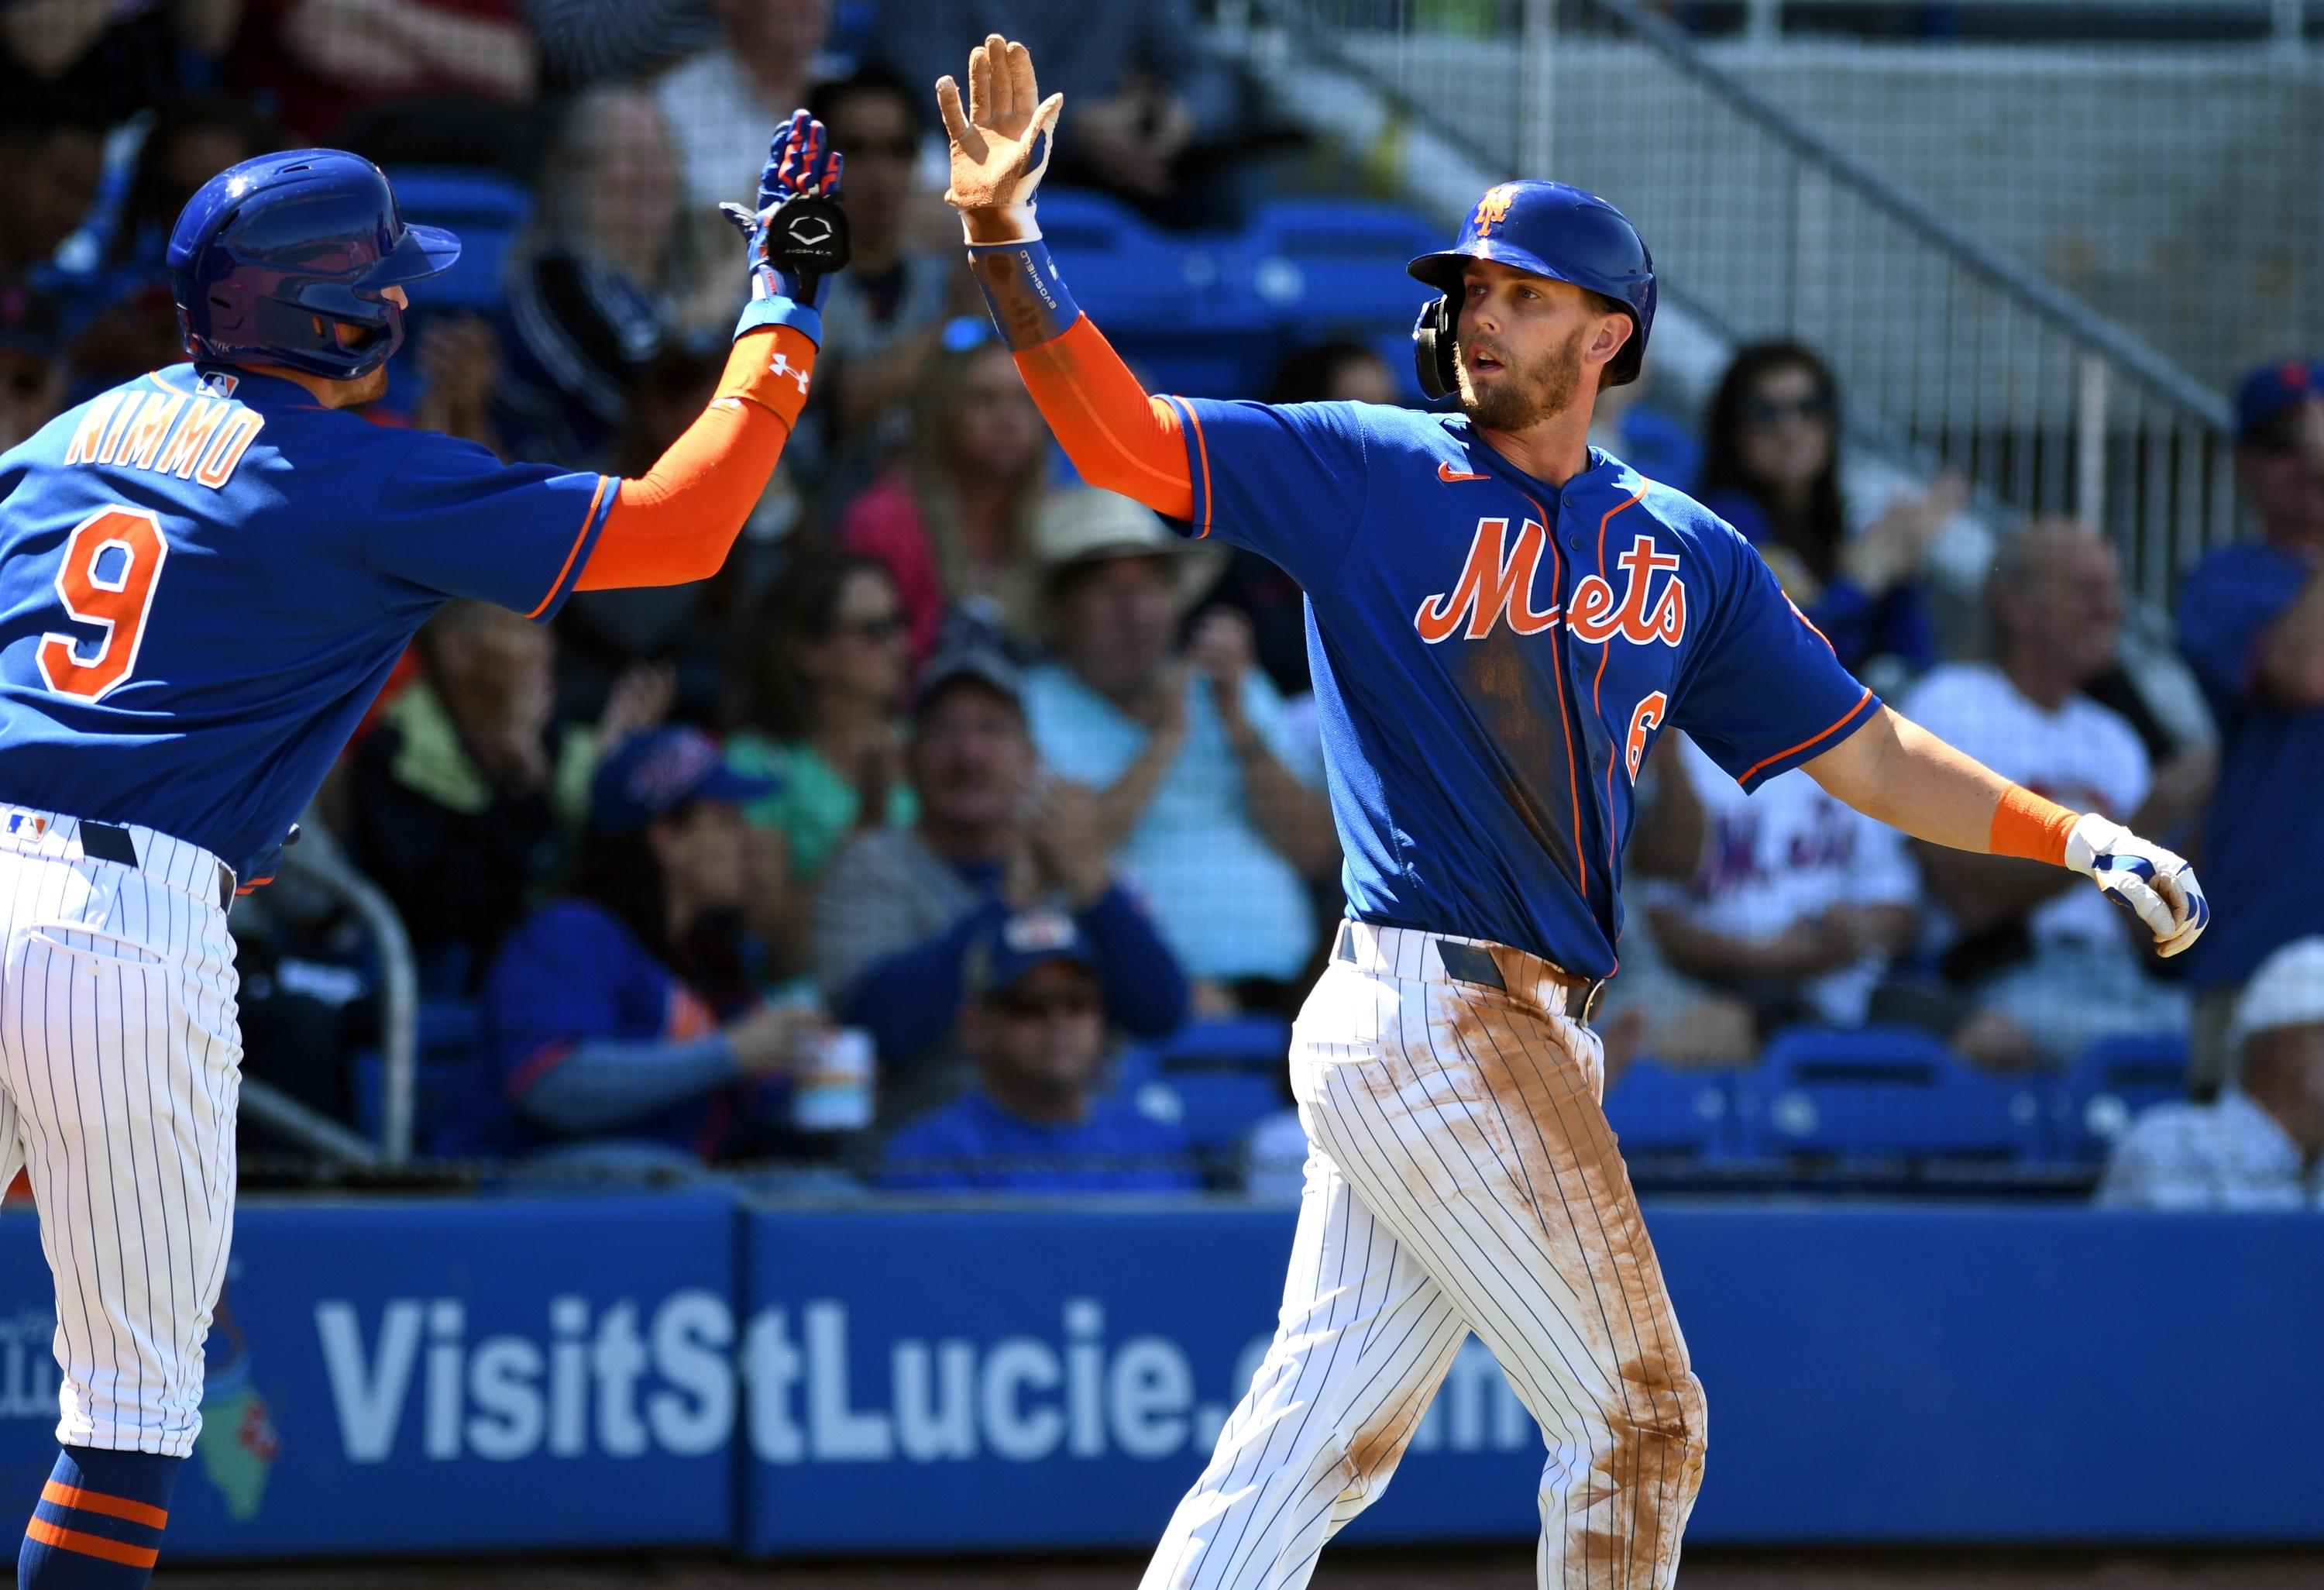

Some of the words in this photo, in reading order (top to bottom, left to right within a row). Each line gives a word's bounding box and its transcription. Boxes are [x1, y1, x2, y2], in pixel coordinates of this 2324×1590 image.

[64, 391, 265, 490] NIMMO
[35, 504, 169, 704] 9
[1414, 517, 1686, 647] Mets
[1625, 690, 1668, 787] 6
[314, 1288, 1532, 1464] VisitStLucie.m
